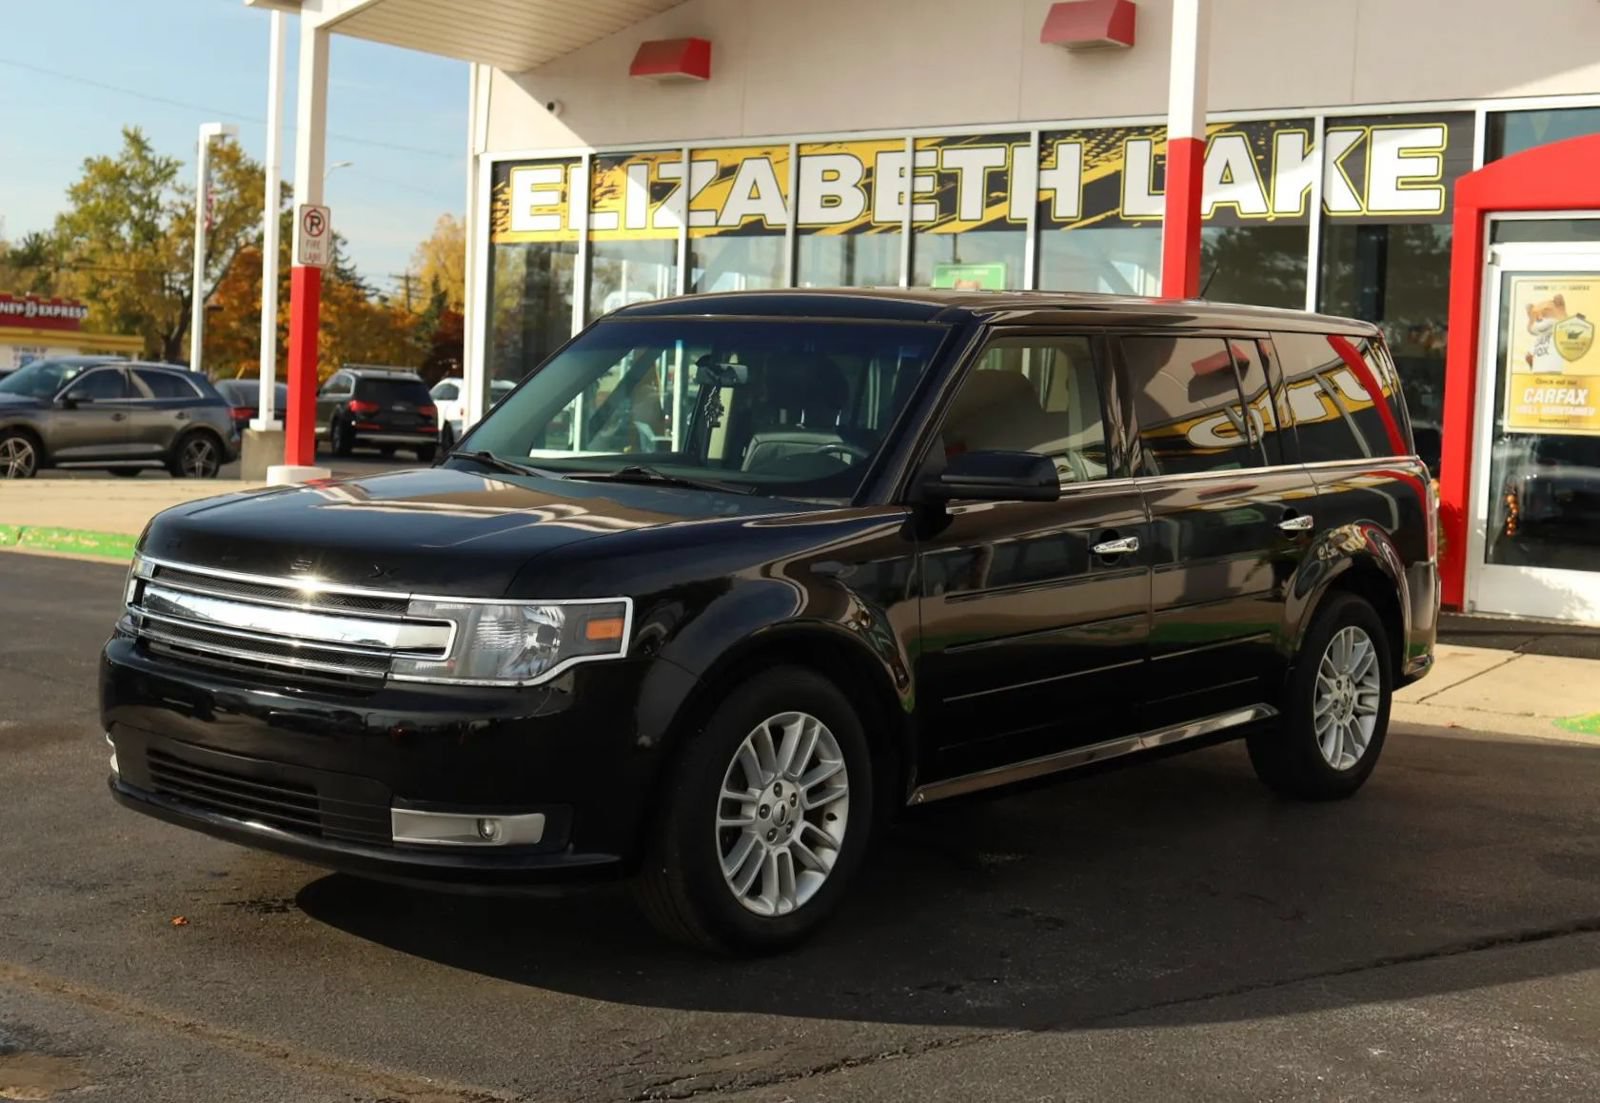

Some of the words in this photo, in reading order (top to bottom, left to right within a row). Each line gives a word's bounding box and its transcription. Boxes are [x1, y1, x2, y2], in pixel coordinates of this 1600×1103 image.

[510, 139, 1082, 232] ELIZABETH
[1120, 123, 1447, 220] LAKE
[39, 304, 88, 319] EXPRESS
[1524, 388, 1588, 405] CARFAX
